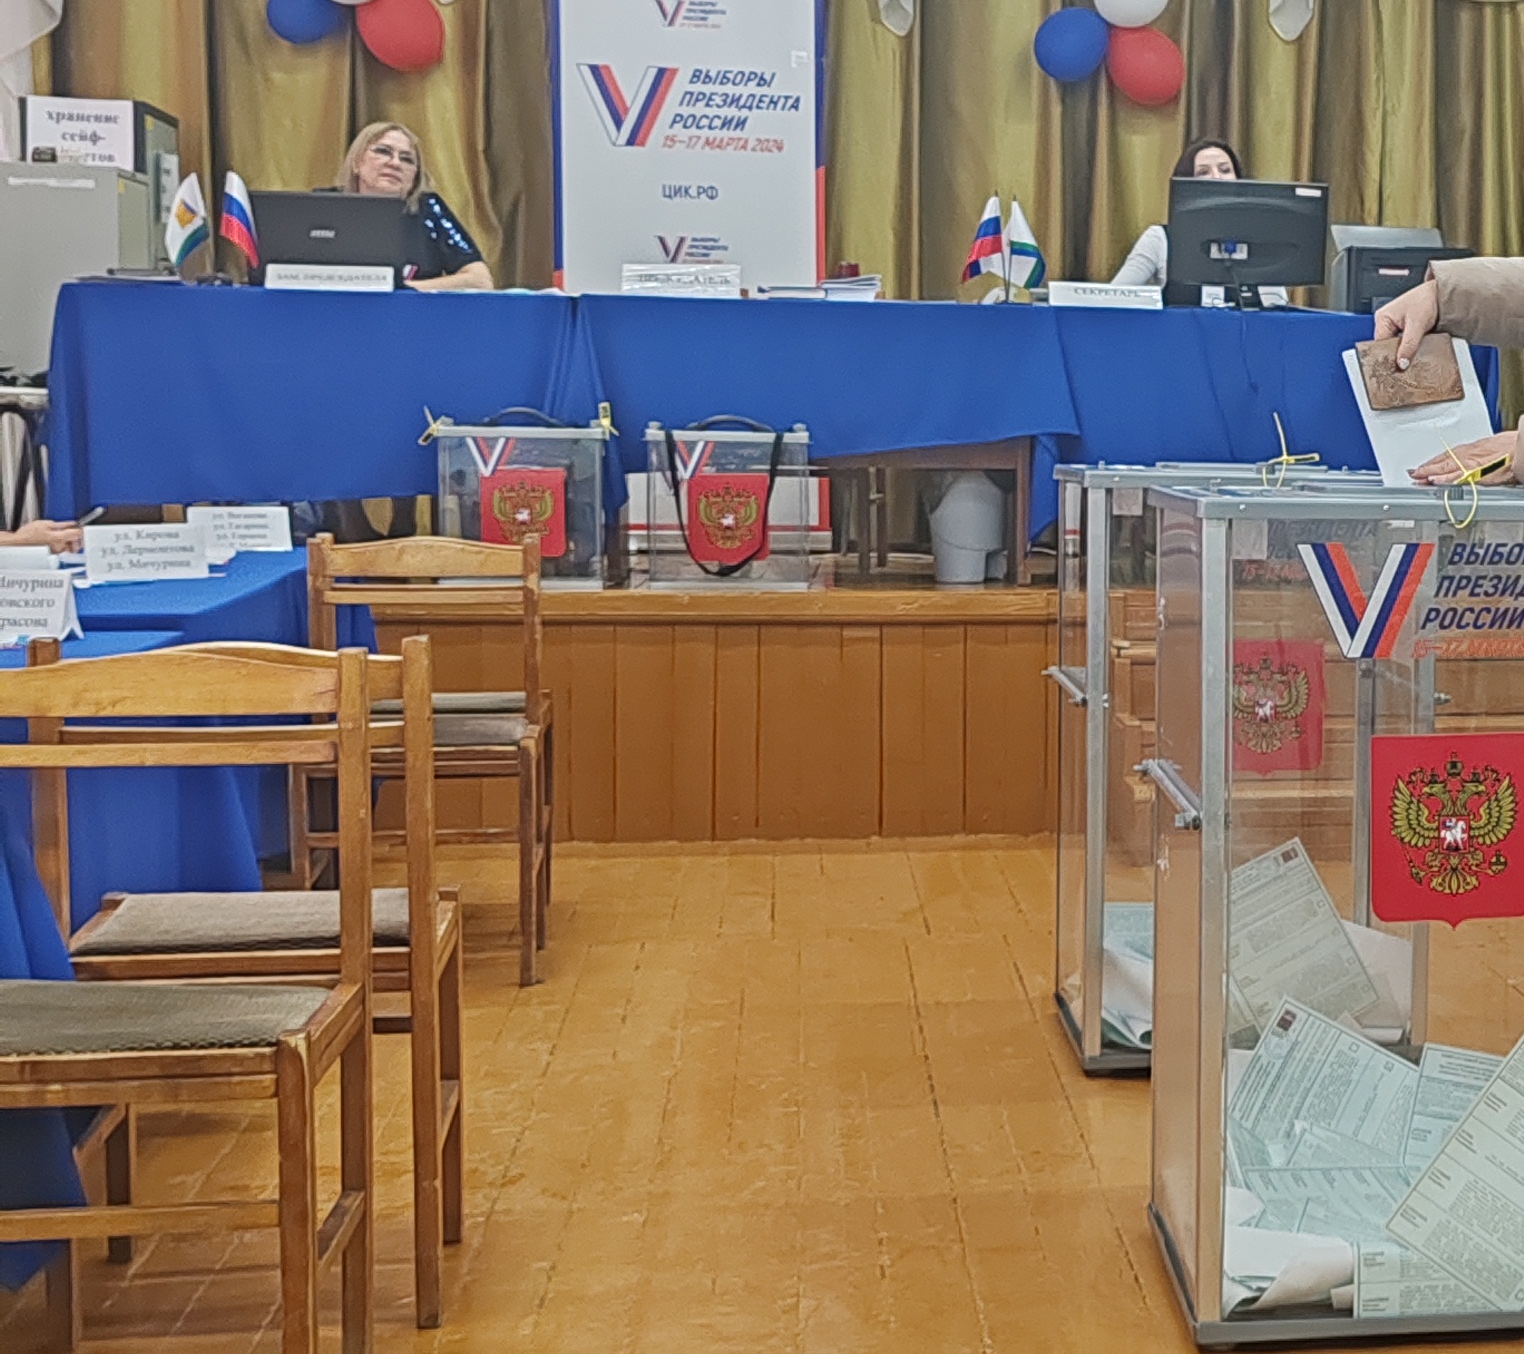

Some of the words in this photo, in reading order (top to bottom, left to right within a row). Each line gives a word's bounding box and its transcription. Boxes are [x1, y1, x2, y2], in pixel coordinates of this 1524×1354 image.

[688, 68, 776, 88] ВЫБОРЫ
[678, 90, 801, 112] ПРЕЗИДЕНТА
[669, 112, 749, 132] РОССИИ
[701, 136, 749, 152] МАРТА
[751, 138, 784, 153] 2024
[662, 184, 719, 200] ЦИК.РФ
